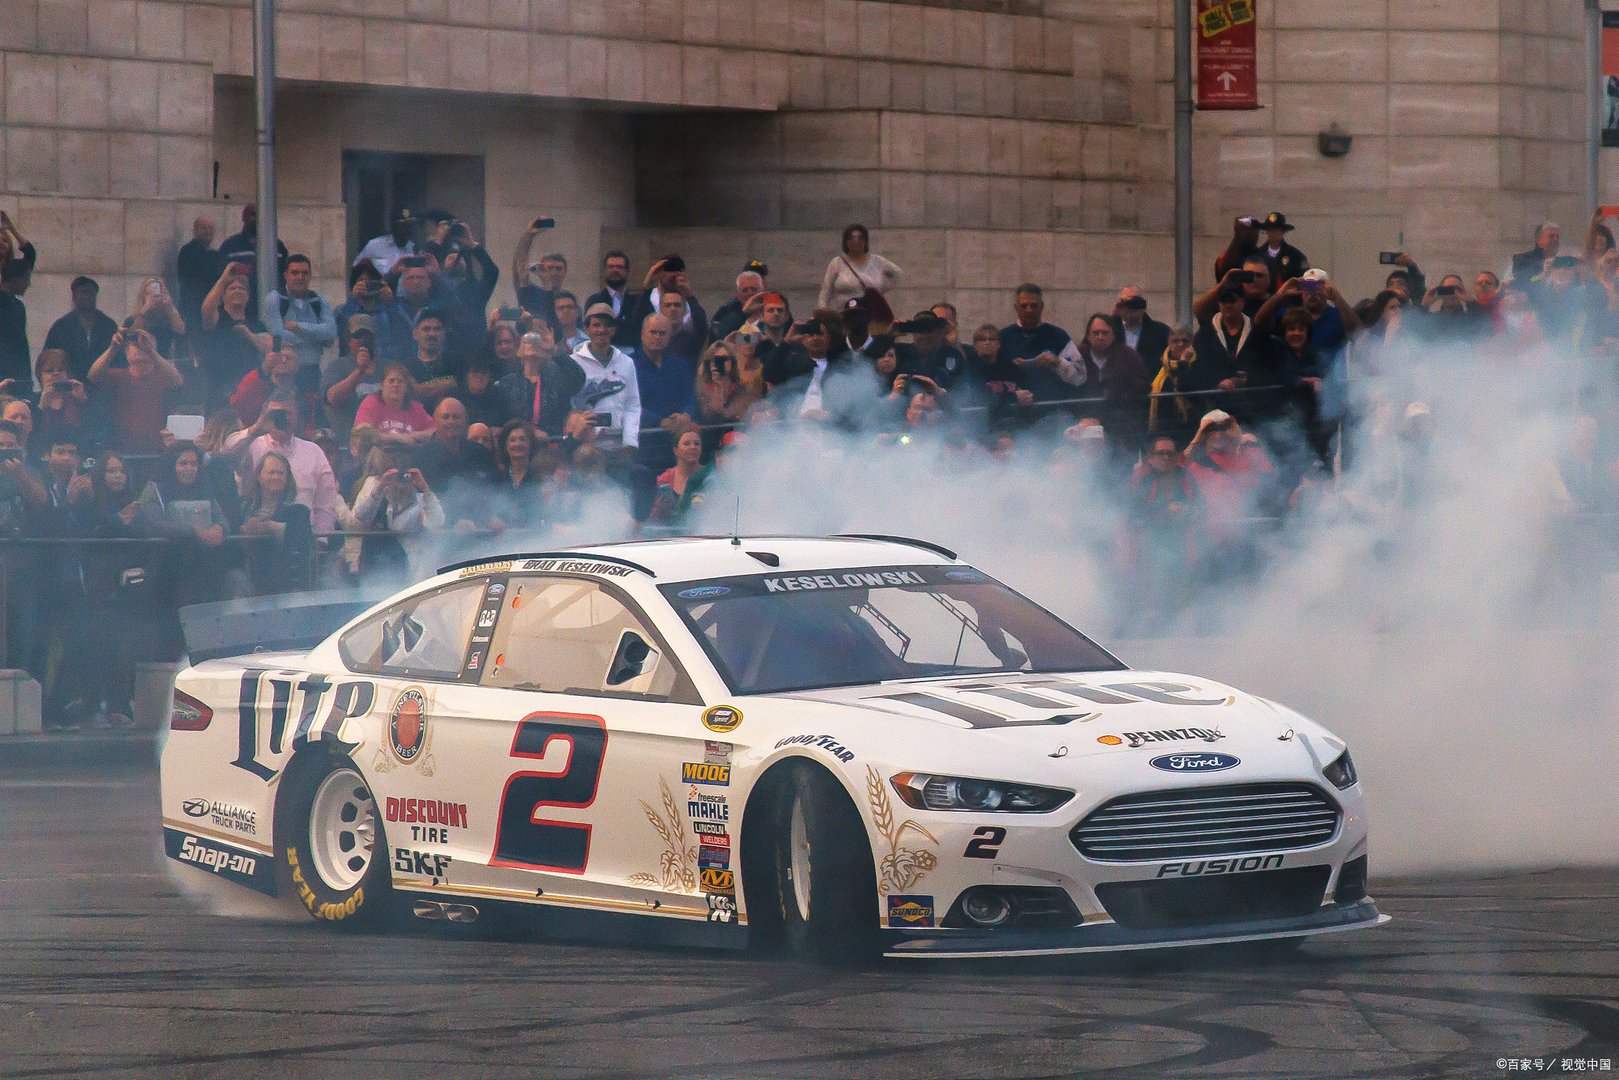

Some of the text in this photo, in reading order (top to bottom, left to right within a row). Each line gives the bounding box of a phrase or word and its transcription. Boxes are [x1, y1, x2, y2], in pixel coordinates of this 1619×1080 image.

[523, 559, 557, 571] BRAD
[557, 561, 636, 577] KESELOWSKI
[763, 571, 927, 592] KESELOWSKI
[396, 744, 417, 757] BEER
[774, 734, 855, 763] GOODYEAR
[684, 763, 730, 782] MOOG
[1169, 755, 1223, 769] Ford
[487, 711, 608, 875] 2
[211, 801, 256, 824] ALLIANCE
[386, 796, 467, 829] DISCOUNT
[688, 801, 728, 820] MAHLE
[211, 814, 256, 835] TRUCK PARTS
[411, 826, 448, 843] TIRE
[695, 823, 724, 835] LINCOLN
[703, 835, 727, 845] WELDERS
[963, 826, 1007, 859] 2
[179, 836, 256, 876] Snap-on
[395, 848, 452, 877] SKF
[1156, 854, 1284, 878] FUSION
[891, 907, 931, 917] SUNOCO
